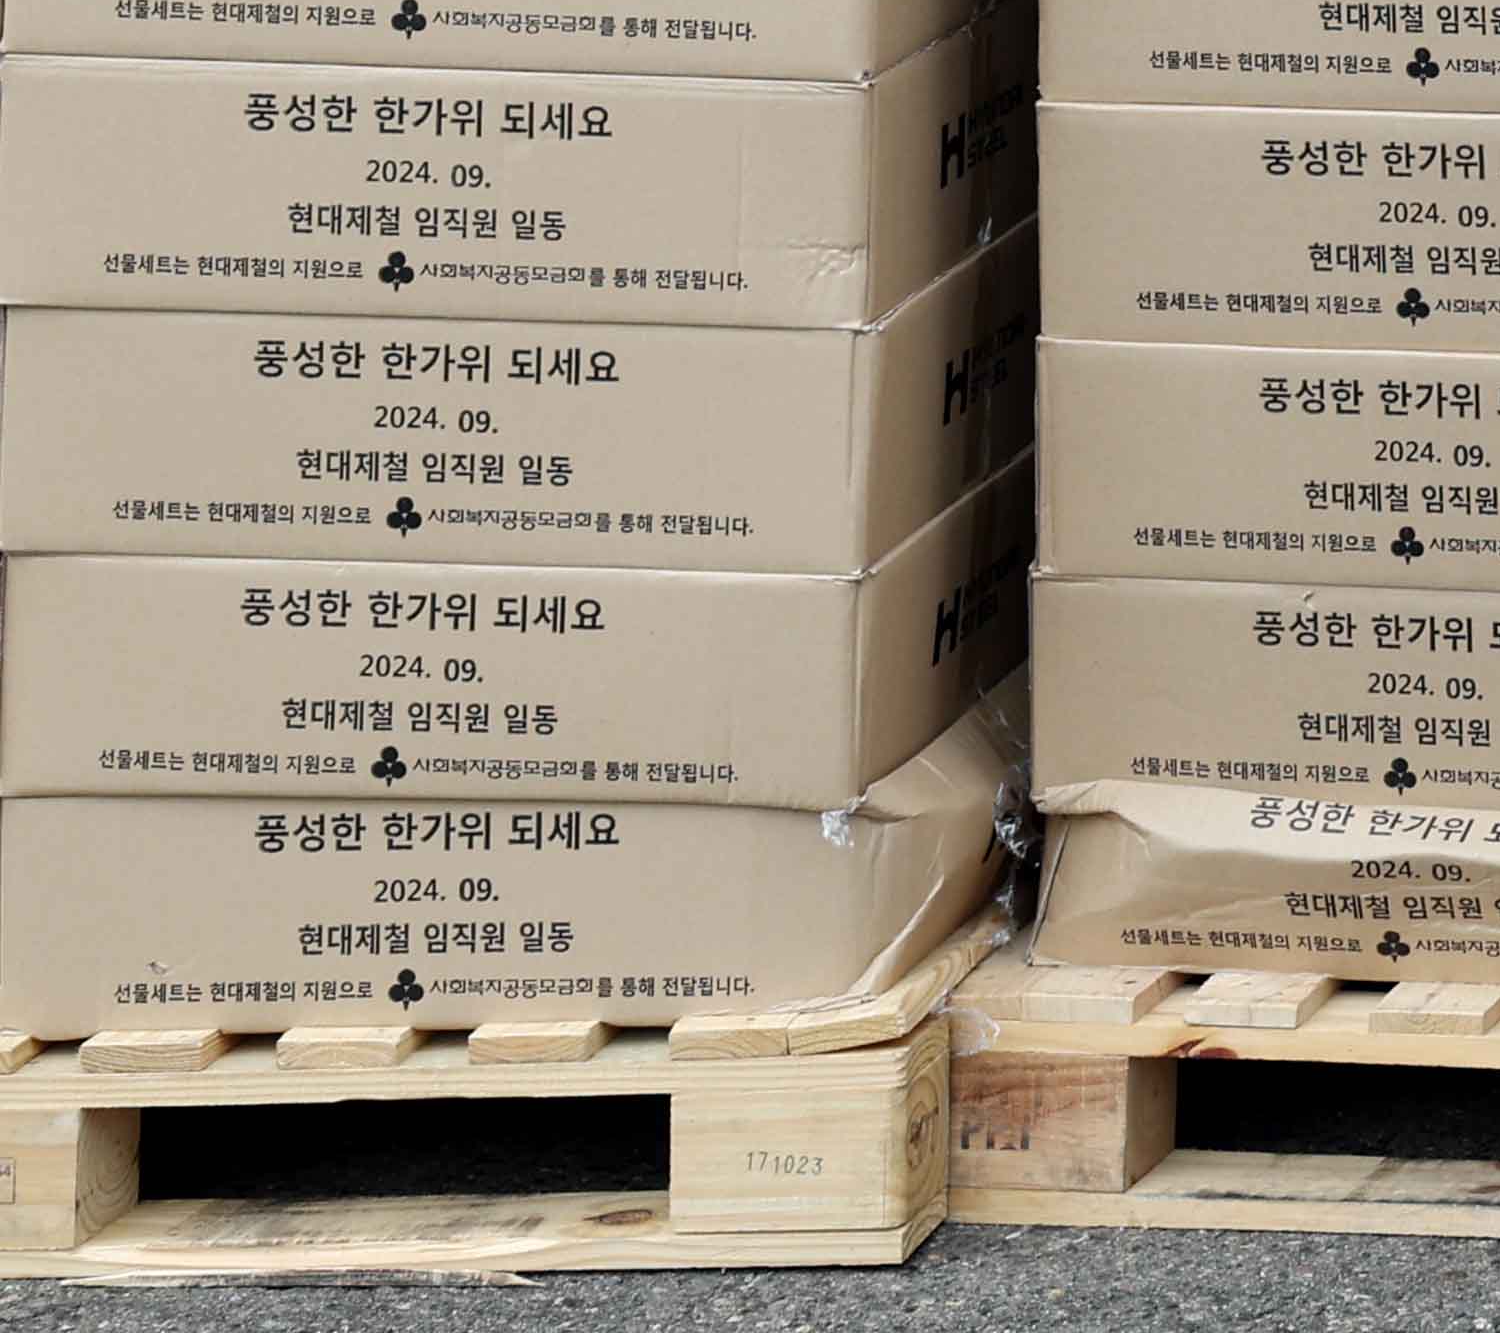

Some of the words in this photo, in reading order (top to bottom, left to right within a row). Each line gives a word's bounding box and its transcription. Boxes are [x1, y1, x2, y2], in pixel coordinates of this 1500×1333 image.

[1318, 0, 1425, 34] 현대제철
[1149, 50, 1231, 71] 선물세트는
[1237, 52, 1320, 74] 현대제철의
[1325, 55, 1393, 75] 지원으로
[254, 812, 367, 854] 풍성한
[382, 811, 491, 852] 한가위
[507, 810, 620, 851] 되세요
[373, 878, 446, 903] 2024.
[458, 877, 500, 902] 09.
[298, 922, 410, 956] 현대제철
[423, 921, 505, 954] 임직원
[519, 921, 574, 953] 일동
[114, 983, 203, 1004] 선물세트는
[209, 981, 296, 1003] 현대제철의
[303, 980, 373, 1002] 지원으로
[620, 976, 655, 998] 통해
[662, 976, 755, 997] 전달됩니다.
[746, 1151, 824, 1175] 171023
